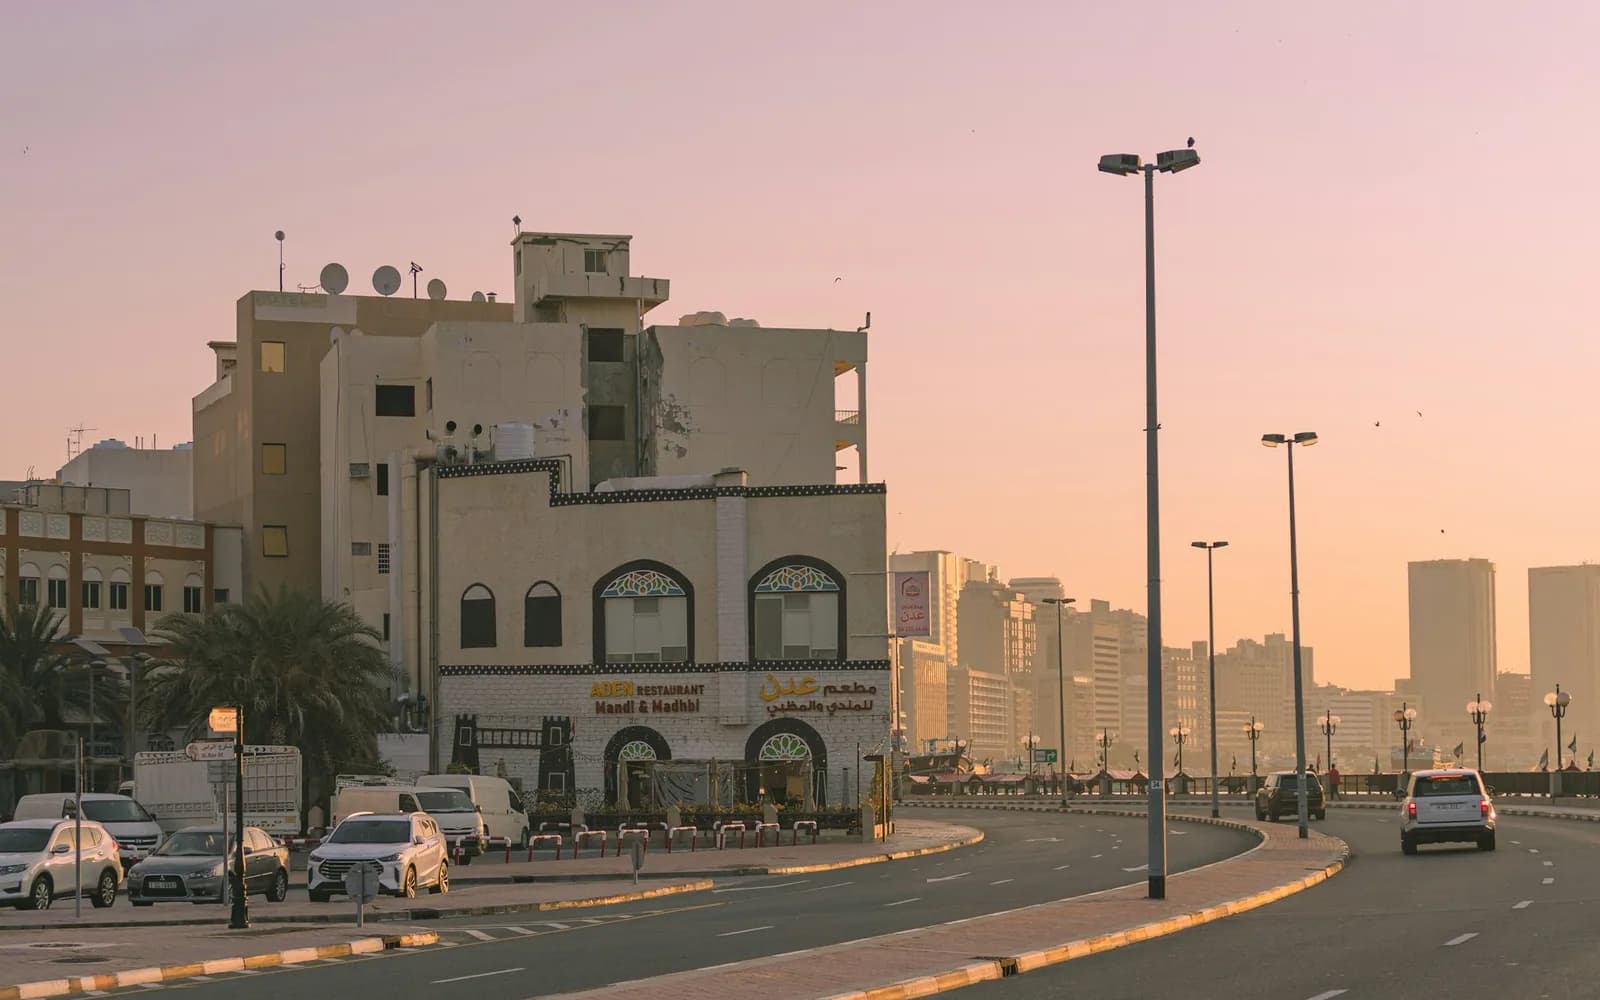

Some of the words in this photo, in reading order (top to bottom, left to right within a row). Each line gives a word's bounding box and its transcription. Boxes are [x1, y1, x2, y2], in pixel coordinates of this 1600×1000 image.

[591, 680, 634, 697] ADEN
[637, 684, 705, 696] RESTAURANT
[759, 673, 820, 703] عدن
[823, 681, 877, 697] مطعم
[595, 699, 635, 714] Mandi
[639, 700, 649, 714] &
[652, 698, 700, 714] Madhbi
[826, 700, 873, 716] للمندي
